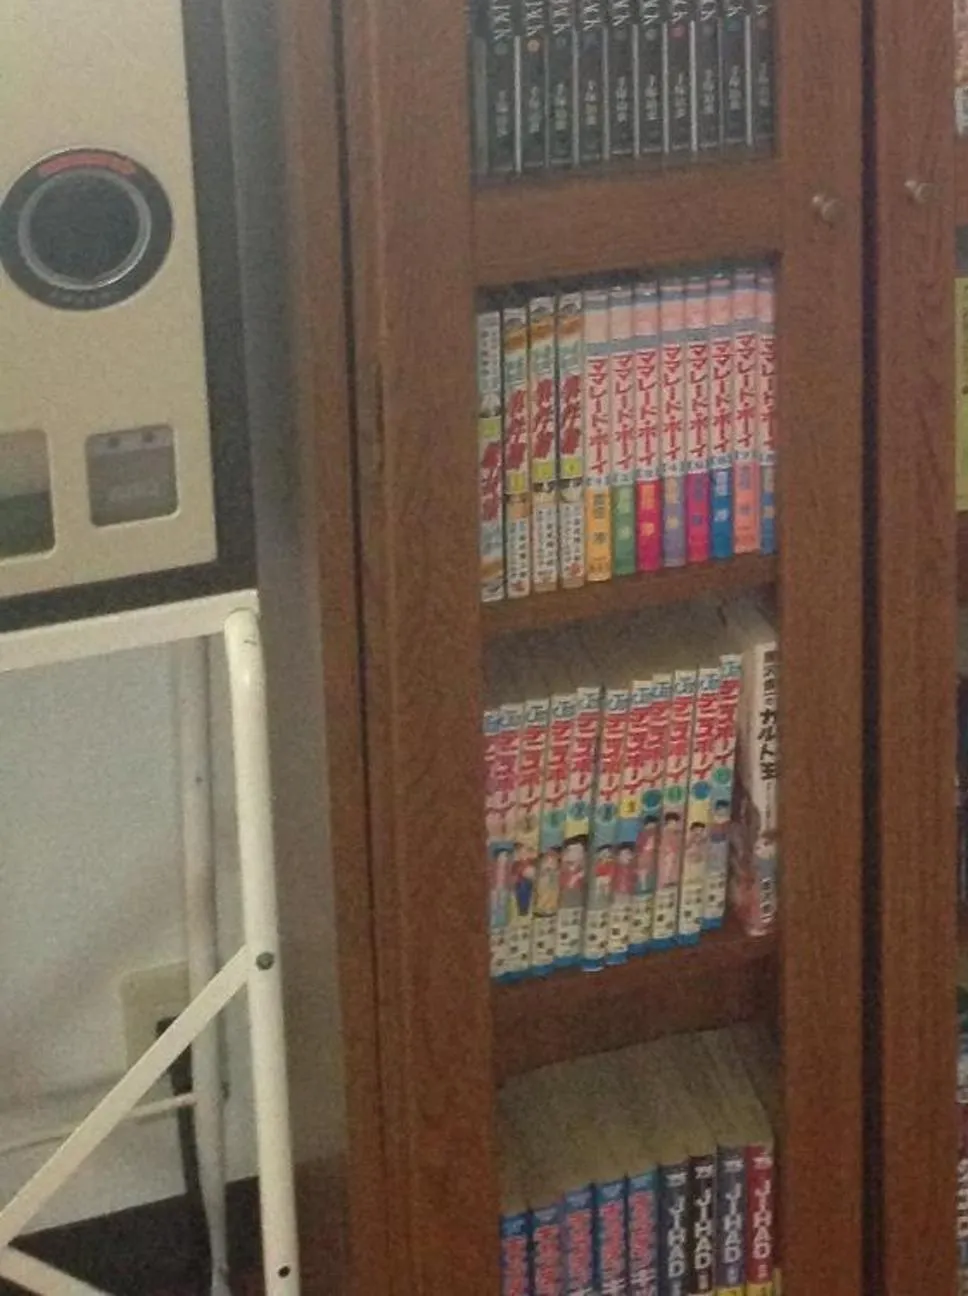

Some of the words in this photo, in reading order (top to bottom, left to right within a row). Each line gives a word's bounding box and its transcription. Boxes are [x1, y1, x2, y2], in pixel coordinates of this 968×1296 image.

[667, 1196, 688, 1278] JIHAD
[694, 1187, 714, 1270] JIHAD
[723, 1182, 743, 1264] JIHAD
[752, 1179, 772, 1260] JIHAD
